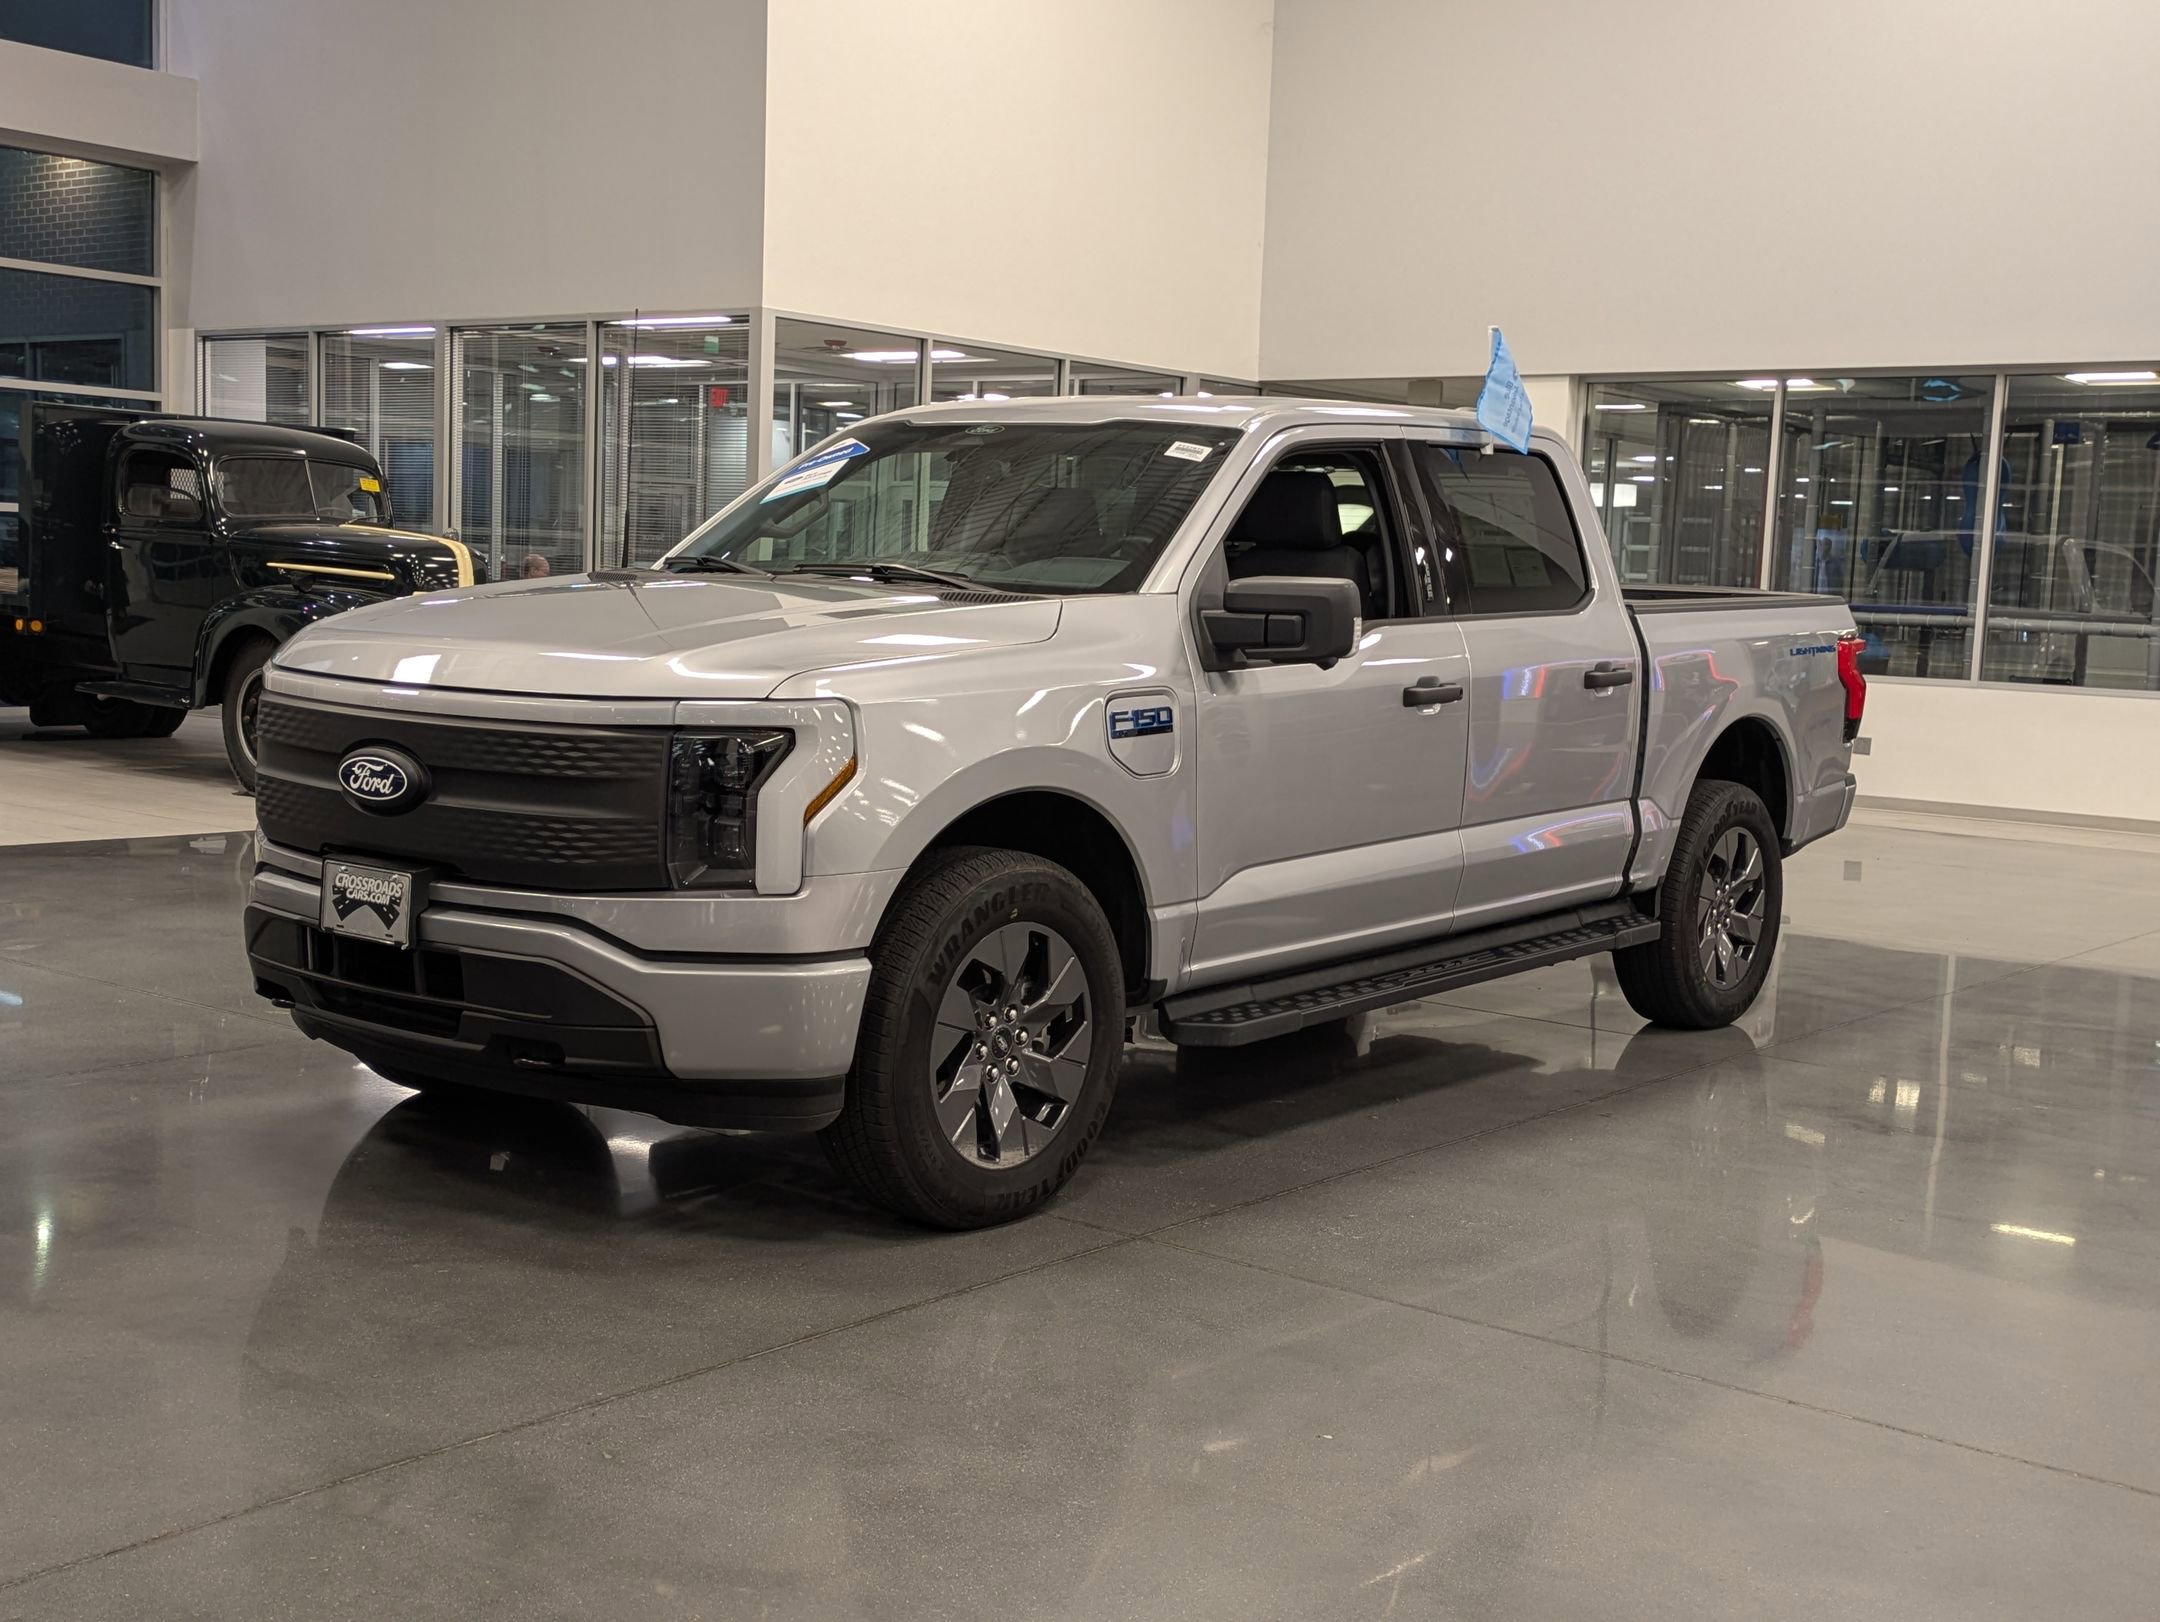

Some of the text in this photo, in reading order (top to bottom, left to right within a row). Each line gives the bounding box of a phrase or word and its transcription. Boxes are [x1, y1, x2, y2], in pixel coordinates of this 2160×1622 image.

[1790, 645, 1836, 656] LIGHTNING
[1109, 706, 1173, 732] F-150
[350, 761, 395, 794] Ford
[335, 873, 403, 898] CROSSROADS
[346, 888, 391, 906] CARS.COM
[926, 882, 1050, 986] WRANGLER
